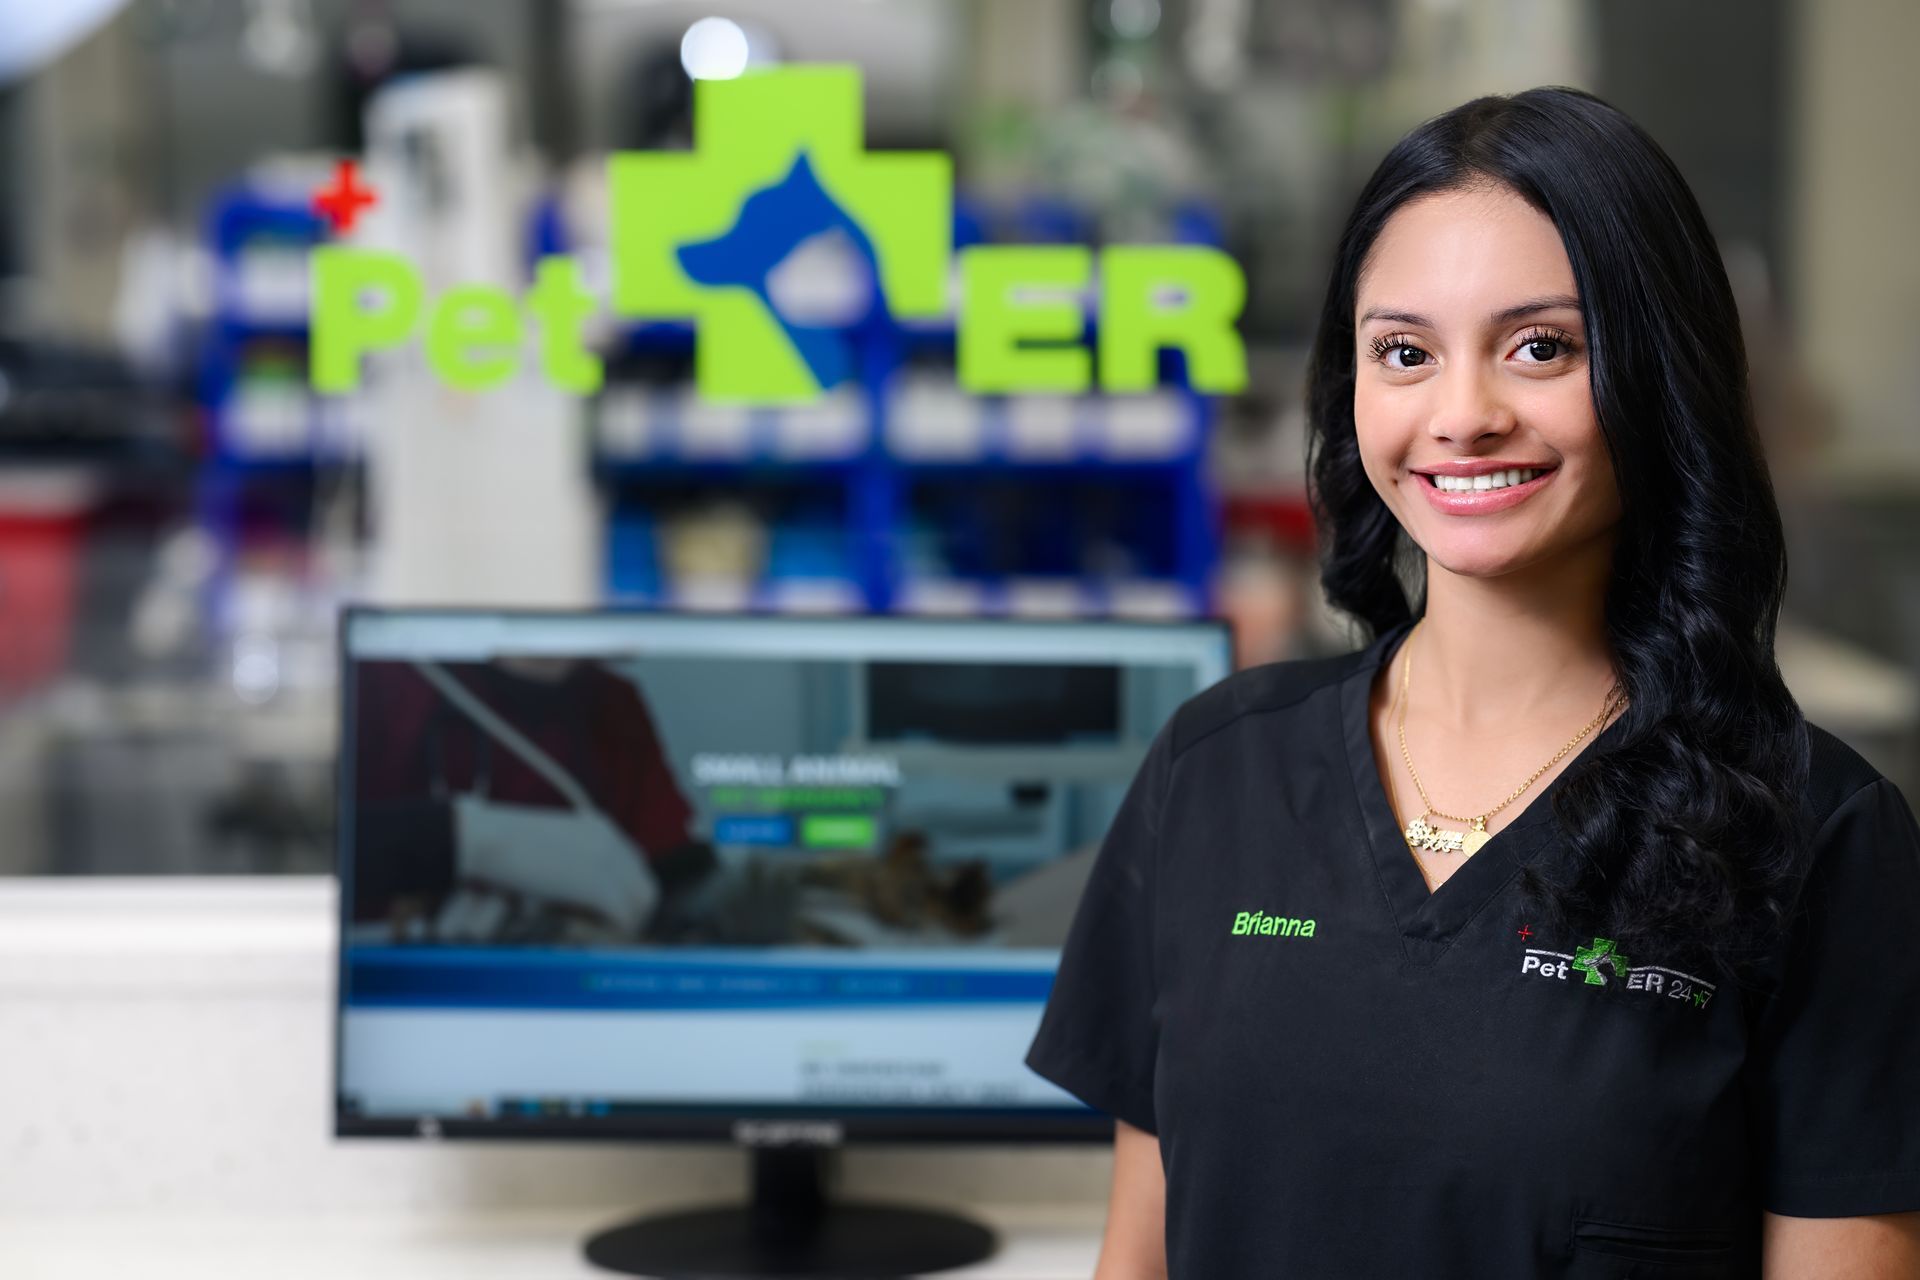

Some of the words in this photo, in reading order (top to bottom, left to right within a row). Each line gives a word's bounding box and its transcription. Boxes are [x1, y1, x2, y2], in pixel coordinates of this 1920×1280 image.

[311, 248, 604, 393] Pet
[958, 246, 1248, 393] ER
[1231, 910, 1316, 938] Brianna
[1521, 955, 1569, 980] Pet
[1626, 972, 1666, 994] ER
